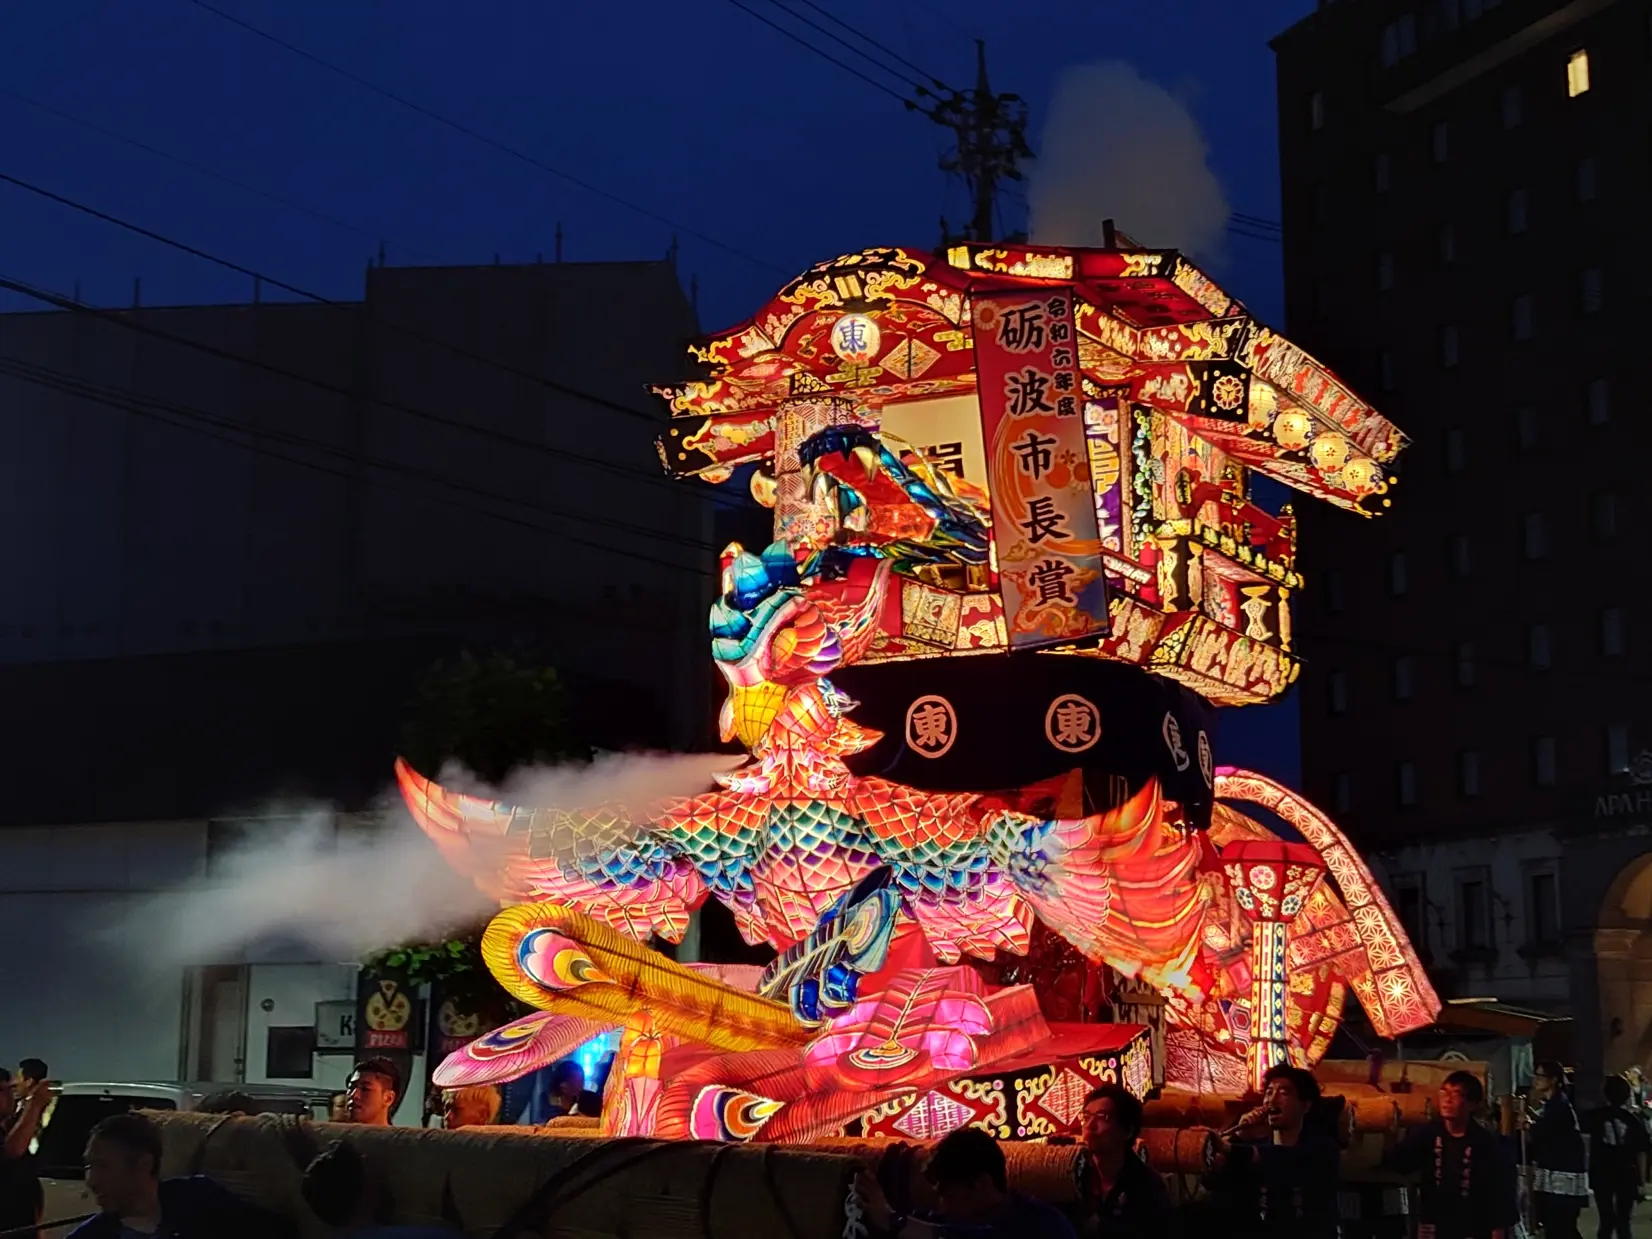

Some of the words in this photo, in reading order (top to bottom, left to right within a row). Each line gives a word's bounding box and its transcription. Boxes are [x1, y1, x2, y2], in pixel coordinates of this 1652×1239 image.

[838, 320, 868, 354] 東
[1047, 298, 1077, 417] 令和六年度
[998, 303, 1075, 607] 砺波市長賞
[912, 704, 949, 747] 東
[1056, 702, 1092, 745] 東
